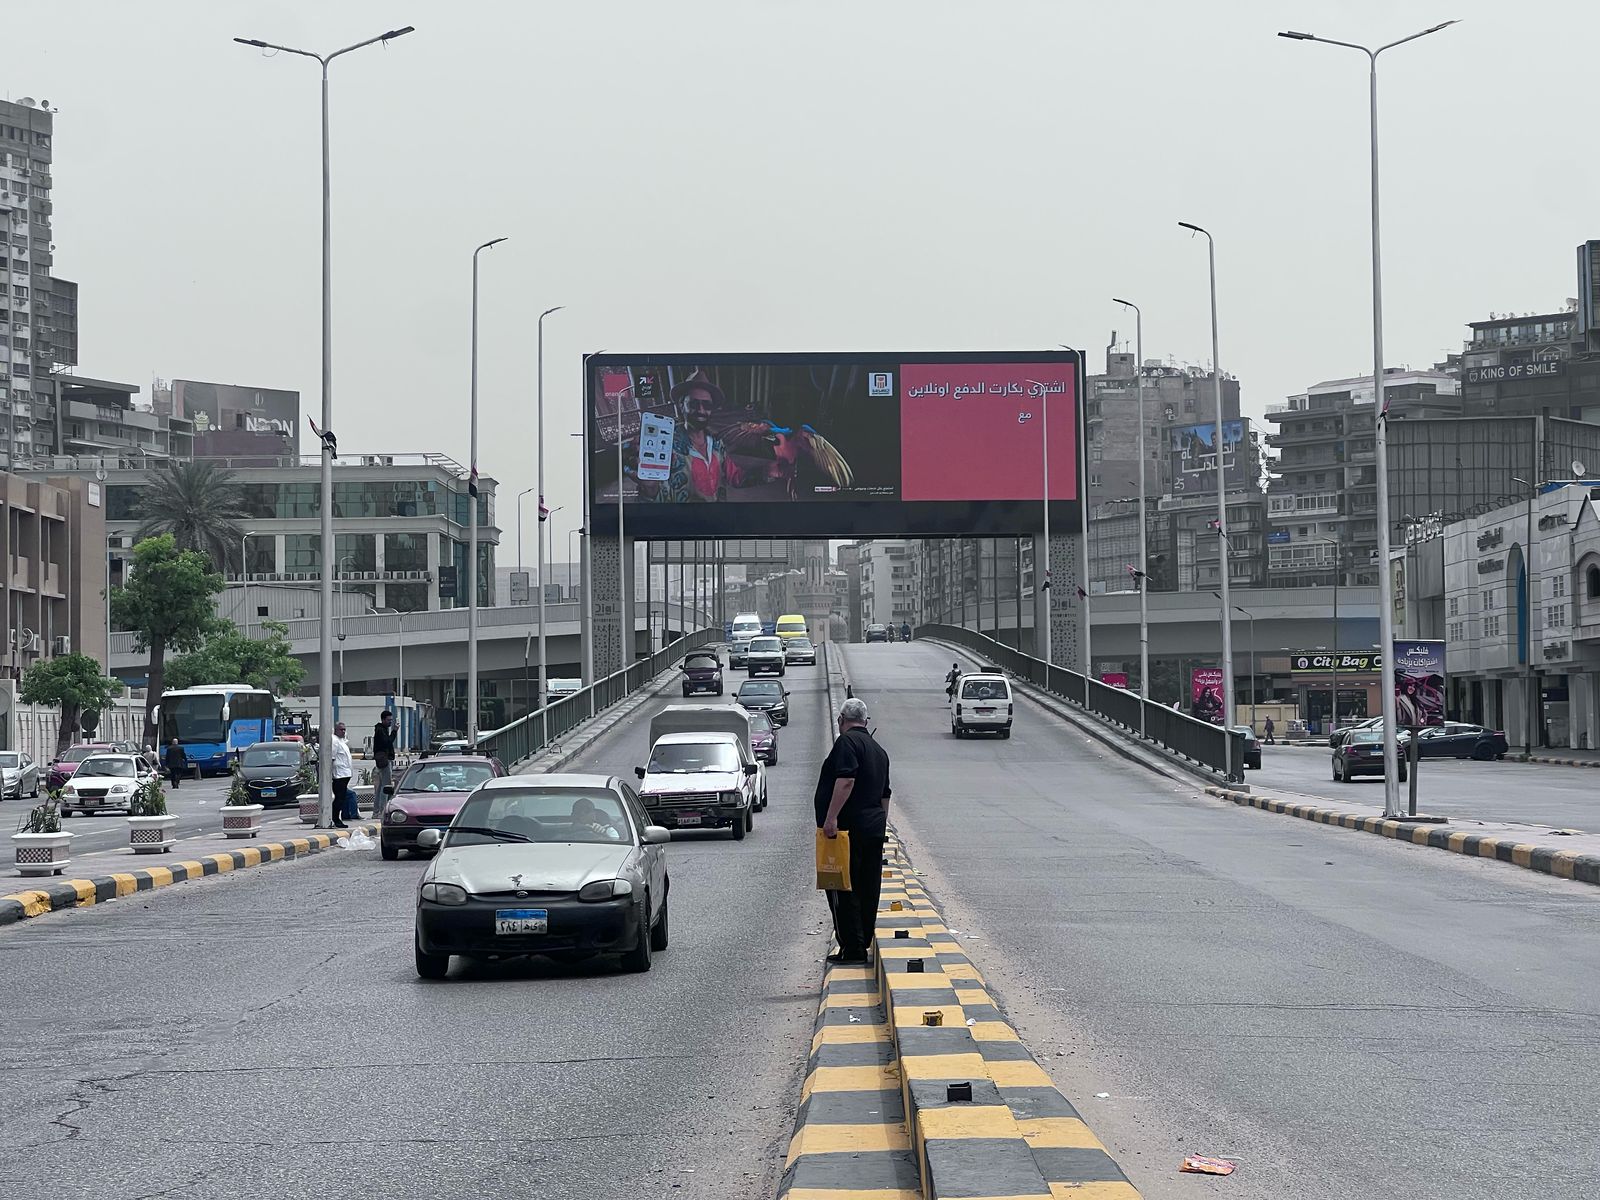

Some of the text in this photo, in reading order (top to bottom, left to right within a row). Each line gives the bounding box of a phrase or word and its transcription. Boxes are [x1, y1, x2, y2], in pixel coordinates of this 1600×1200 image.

[1480, 362, 1557, 379] KING OF SMILE
[908, 381, 1065, 399] اشتري بكارت الدفع اونلاين
[1018, 411, 1032, 423] مع
[1313, 656, 1369, 669] City Bag
